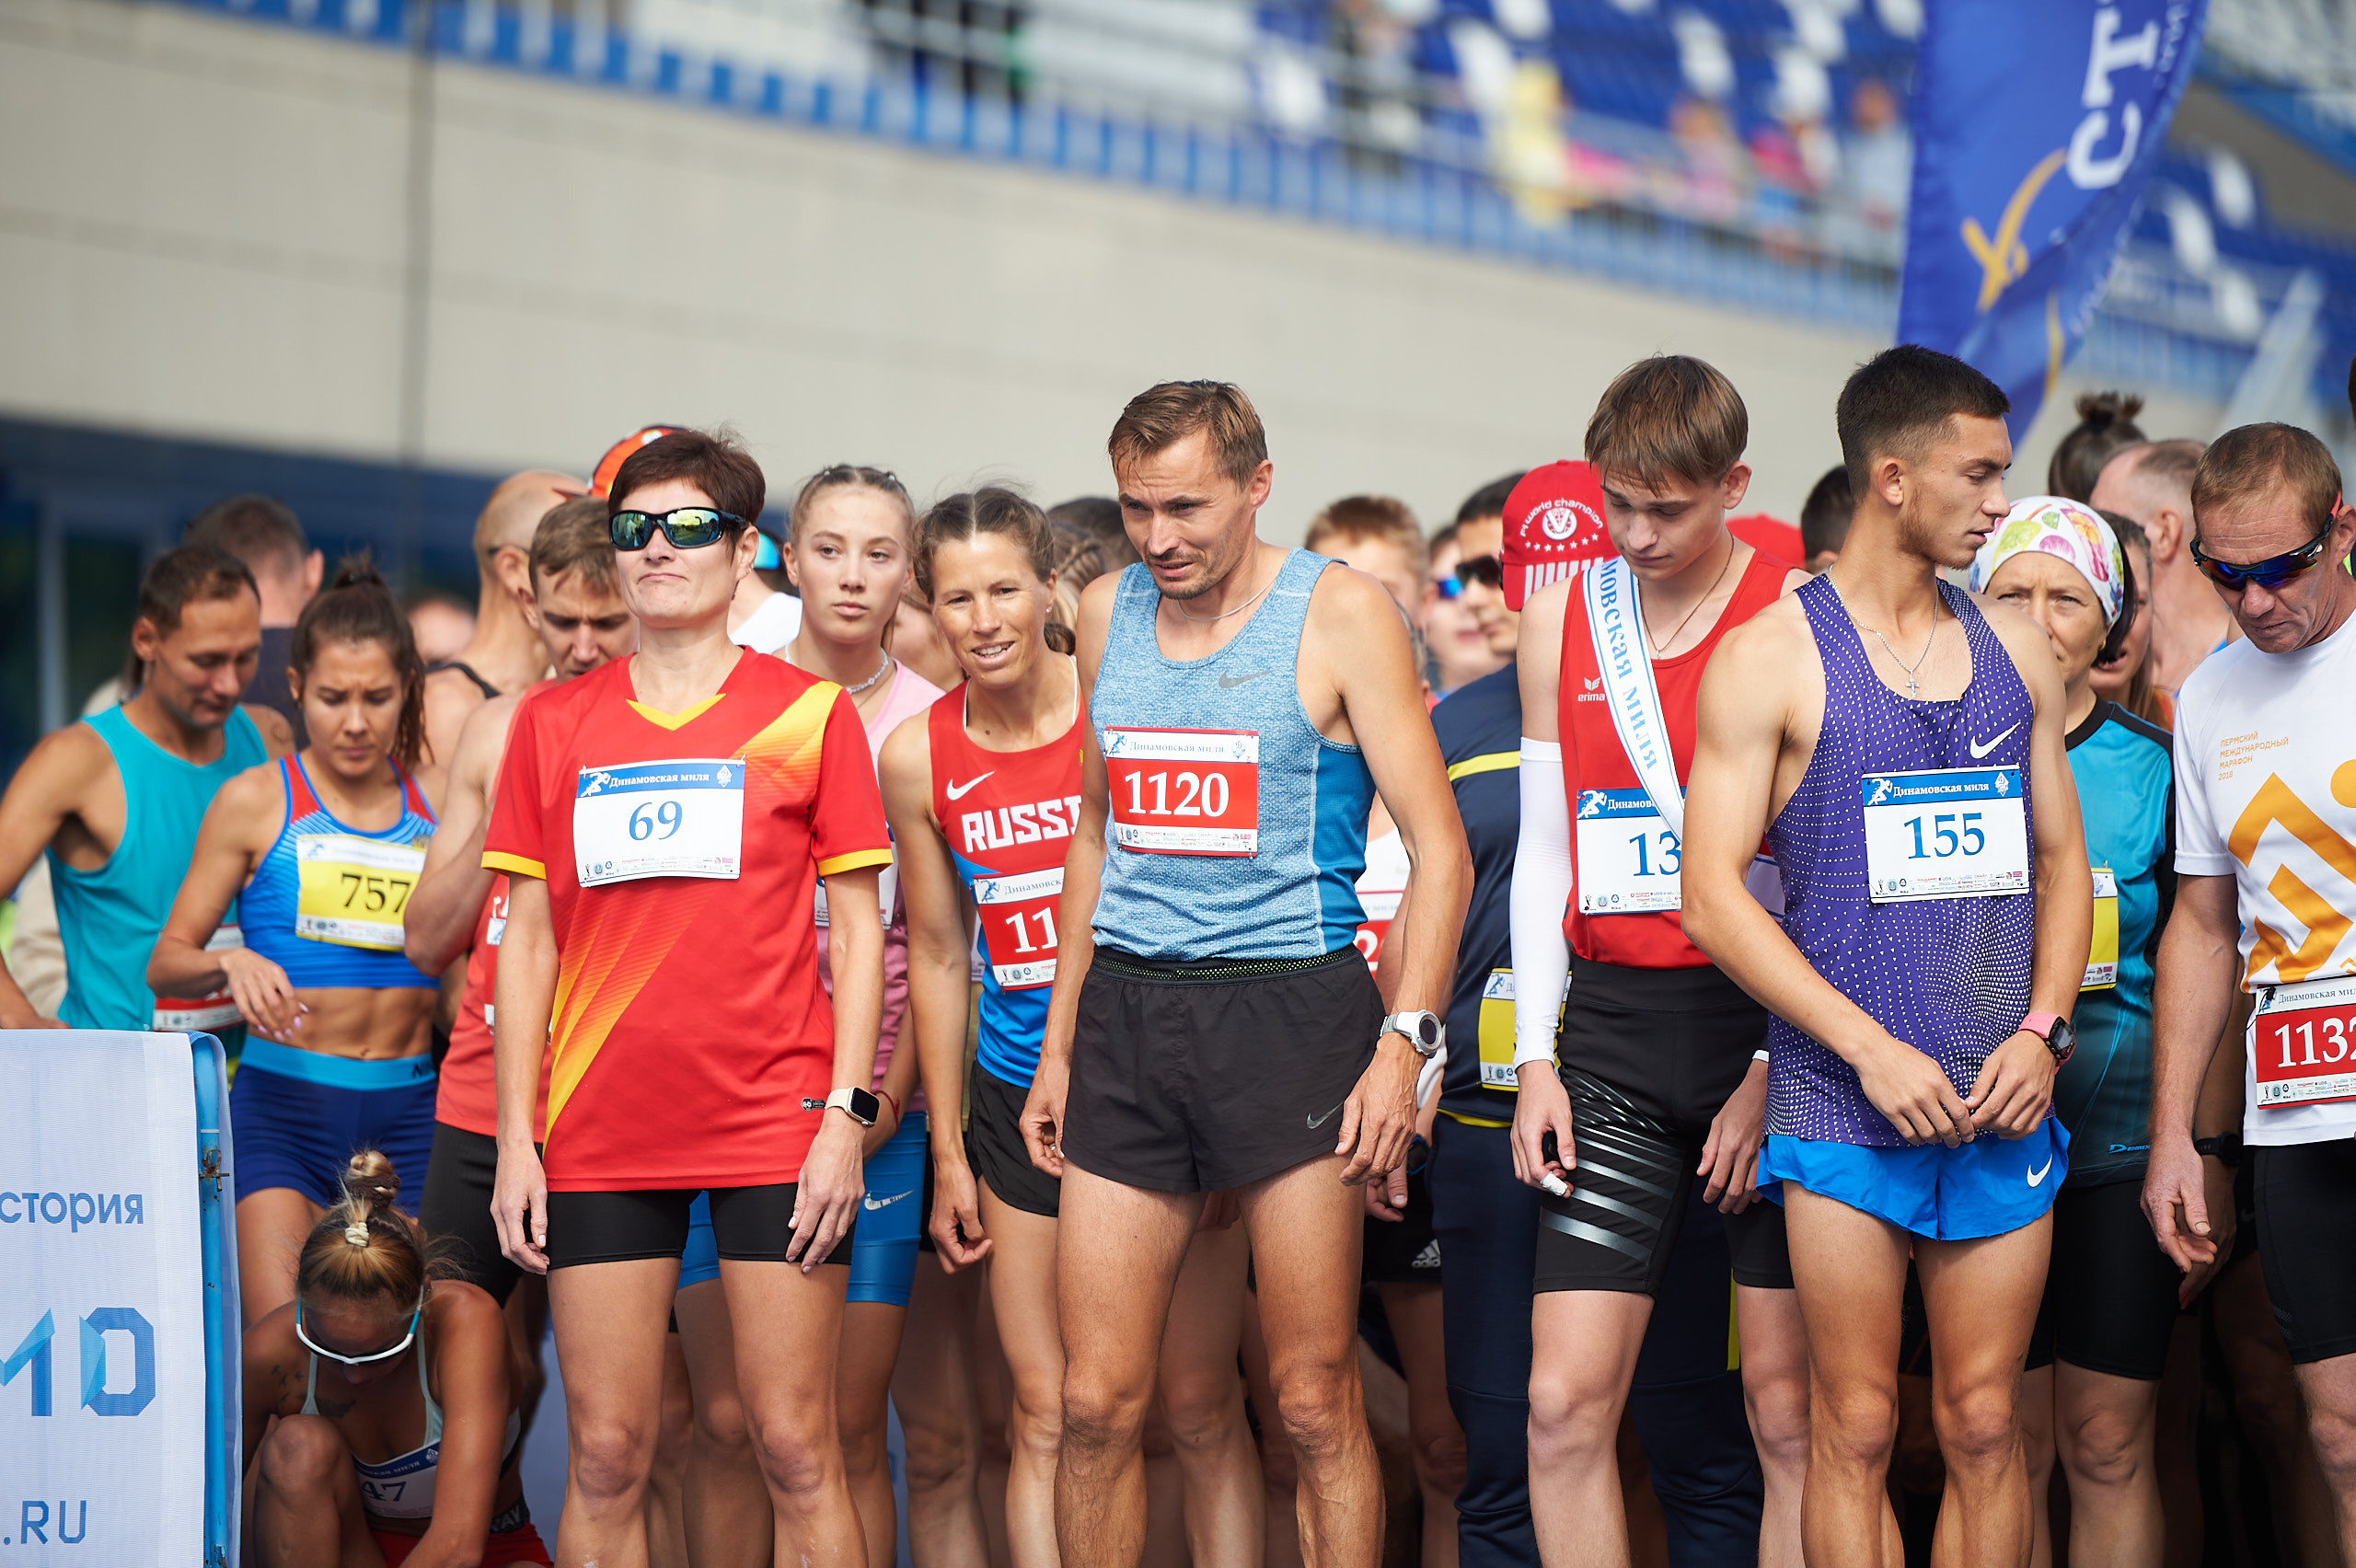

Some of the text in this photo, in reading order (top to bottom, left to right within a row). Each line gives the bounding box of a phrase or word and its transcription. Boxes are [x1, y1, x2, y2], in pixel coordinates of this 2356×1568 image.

[2065, 0, 2161, 190] СТ
[1525, 500, 1553, 525] world
[1554, 497, 1603, 529] champion
[1577, 692, 1606, 702] erima
[1129, 741, 1225, 753] Динамовская миля
[2220, 736, 2289, 758] МЕЖДУНАРОДНЫЙ
[2221, 731, 2258, 747] ПЕРМСКИЙ
[2218, 770, 2234, 781] 2018
[2219, 755, 2253, 769] МАРАФОН
[608, 773, 710, 789] Динамовская миля
[1125, 770, 1230, 818] 1120
[1893, 783, 1990, 798] Динамовская миля
[629, 801, 683, 841] 69
[1903, 812, 1985, 859] 155
[1629, 830, 1681, 877] 13
[341, 872, 411, 914] 757
[1005, 906, 1058, 953] 11
[2278, 990, 2336, 1004] Динамовская
[0, 1192, 144, 1233] стория
[361, 1481, 407, 1502] 47
[4, 1500, 87, 1545] .RU
